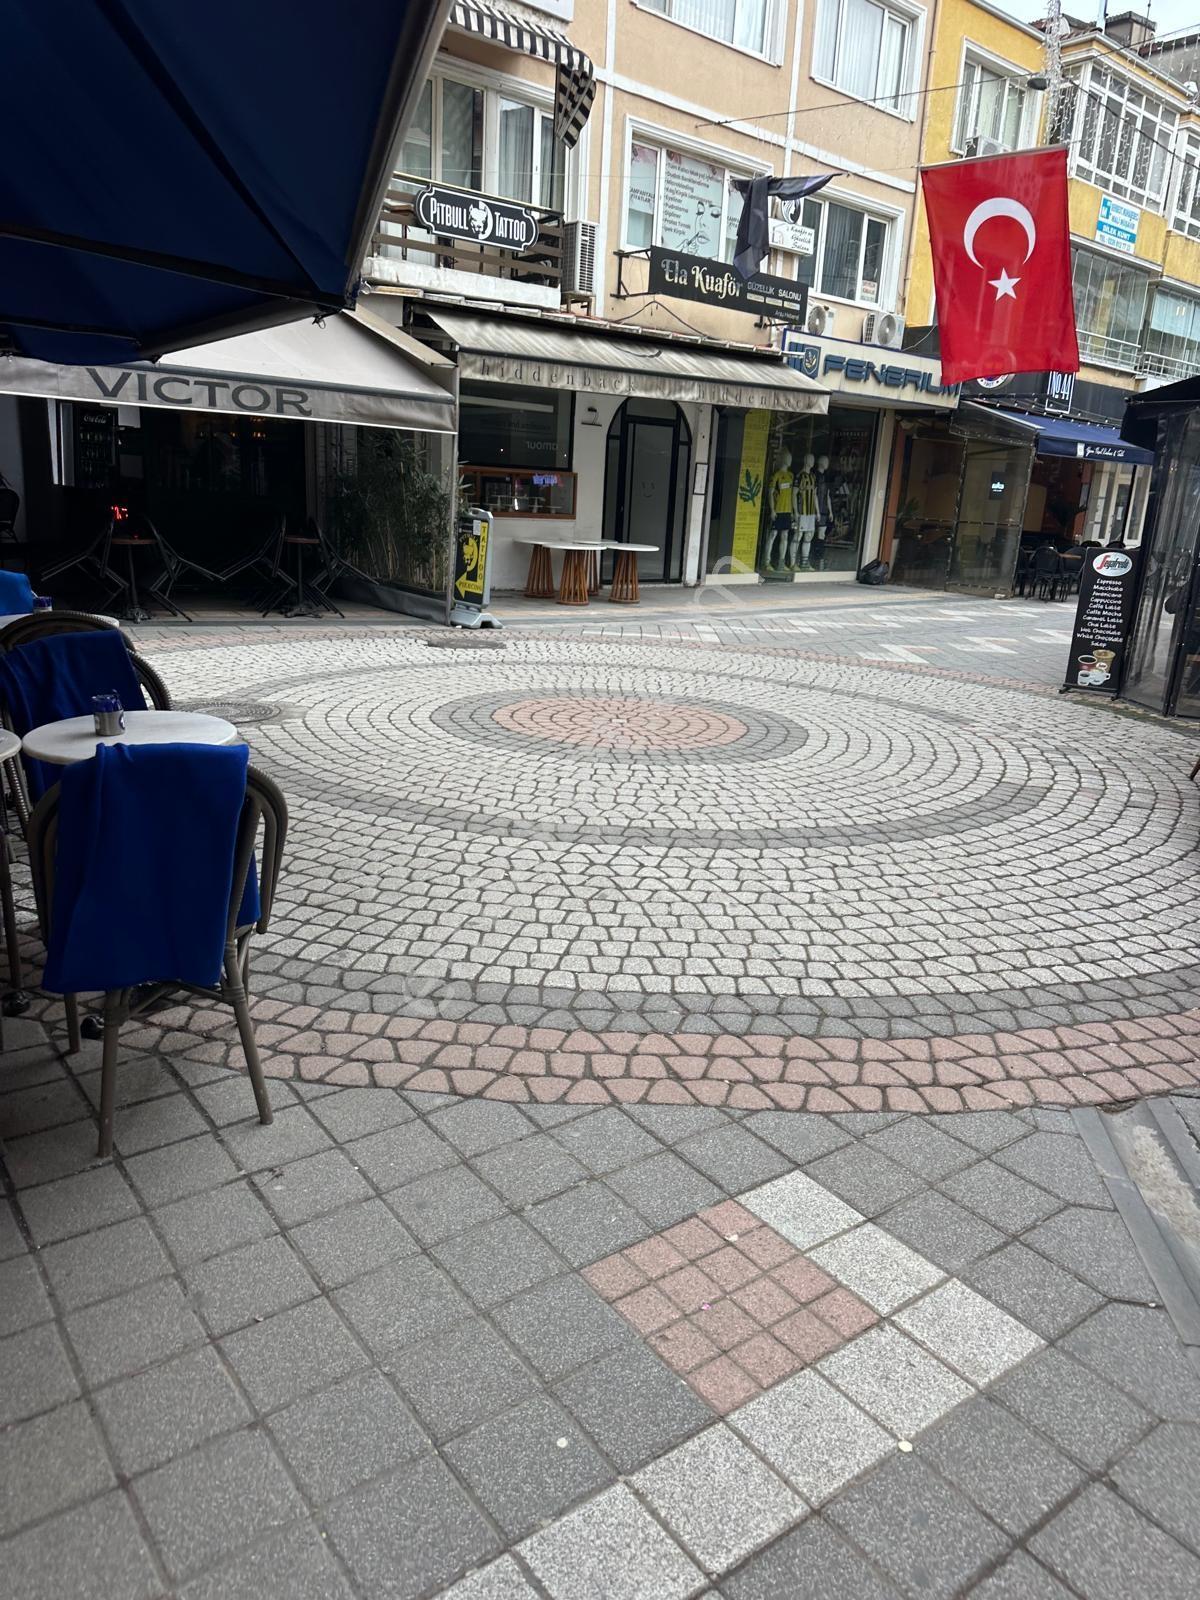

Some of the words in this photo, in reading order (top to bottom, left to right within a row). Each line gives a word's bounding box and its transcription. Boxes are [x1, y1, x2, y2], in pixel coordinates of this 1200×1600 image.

[494, 211, 526, 242] TATTOO
[661, 258, 687, 286] Ela
[691, 265, 743, 300] Kuaför
[778, 288, 801, 301] SALONU
[481, 358, 635, 392] hiddenback
[1060, 373, 1071, 400] 44
[86, 368, 312, 416] VICTOR
[698, 384, 814, 409] hiddenback
[479, 525, 487, 580] TATTOO
[1093, 584, 1123, 592] Macchiato
[1097, 578, 1122, 587] Espresso
[1094, 634, 1123, 642] Chocolate
